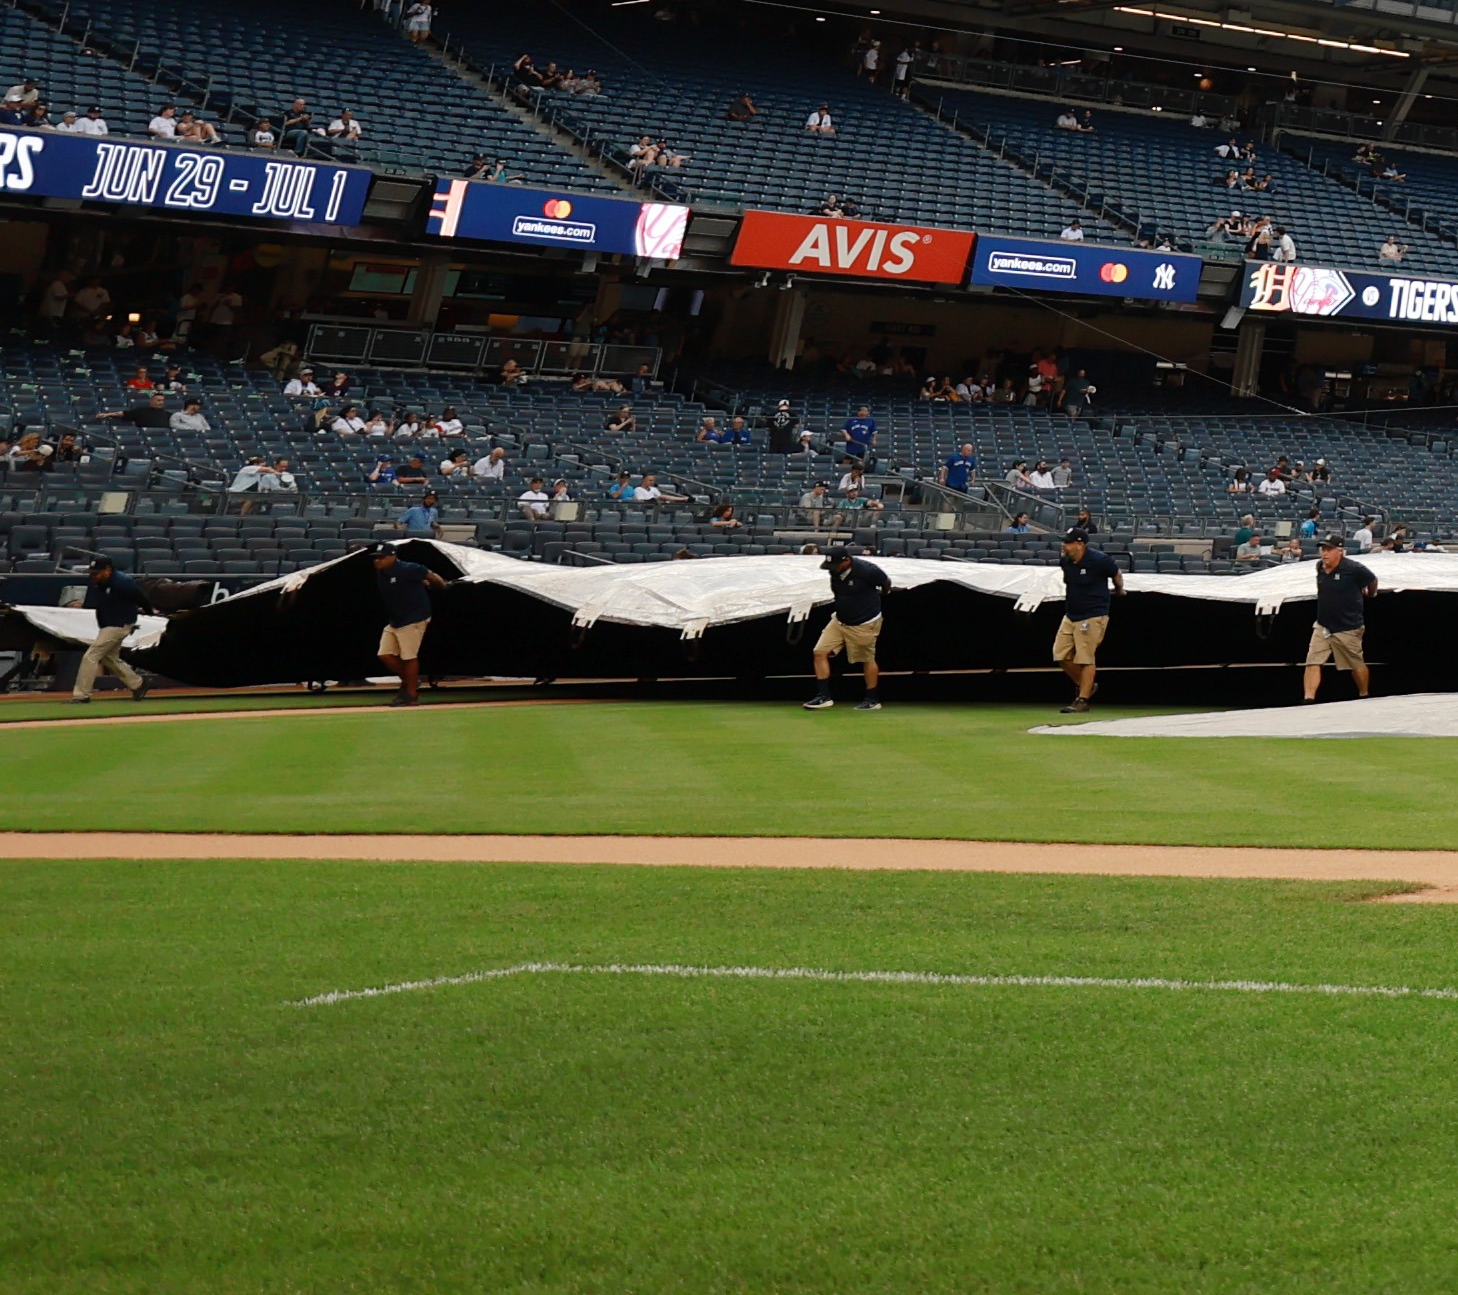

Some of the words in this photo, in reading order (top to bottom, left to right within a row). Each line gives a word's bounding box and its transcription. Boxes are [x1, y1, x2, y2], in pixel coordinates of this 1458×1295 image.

[82, 144, 166, 203] JUN
[165, 153, 225, 208] 29
[252, 162, 316, 219] JUL
[325, 170, 347, 221] 1
[517, 221, 591, 238] yankees.com
[789, 223, 915, 274] AVIS
[992, 256, 1072, 275] yankees.com
